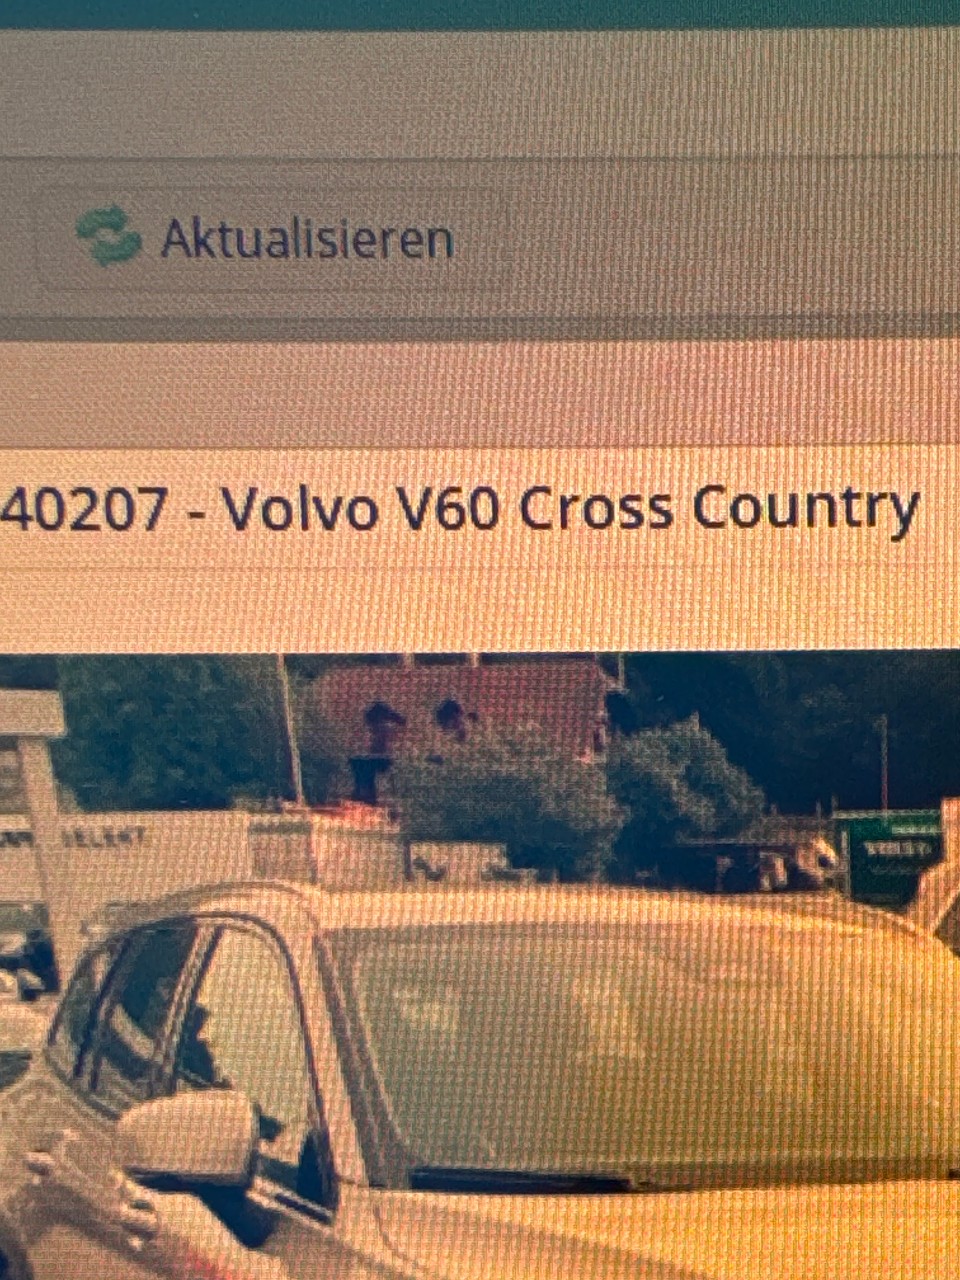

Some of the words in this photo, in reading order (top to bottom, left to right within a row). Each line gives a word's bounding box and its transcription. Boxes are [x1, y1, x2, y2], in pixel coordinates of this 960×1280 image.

[162, 216, 454, 259] Aktualisieren
[0, 486, 167, 532] 40207
[221, 484, 378, 531] Volvo
[397, 486, 500, 530] V60
[521, 486, 672, 531] Cross
[694, 485, 920, 541] Country
